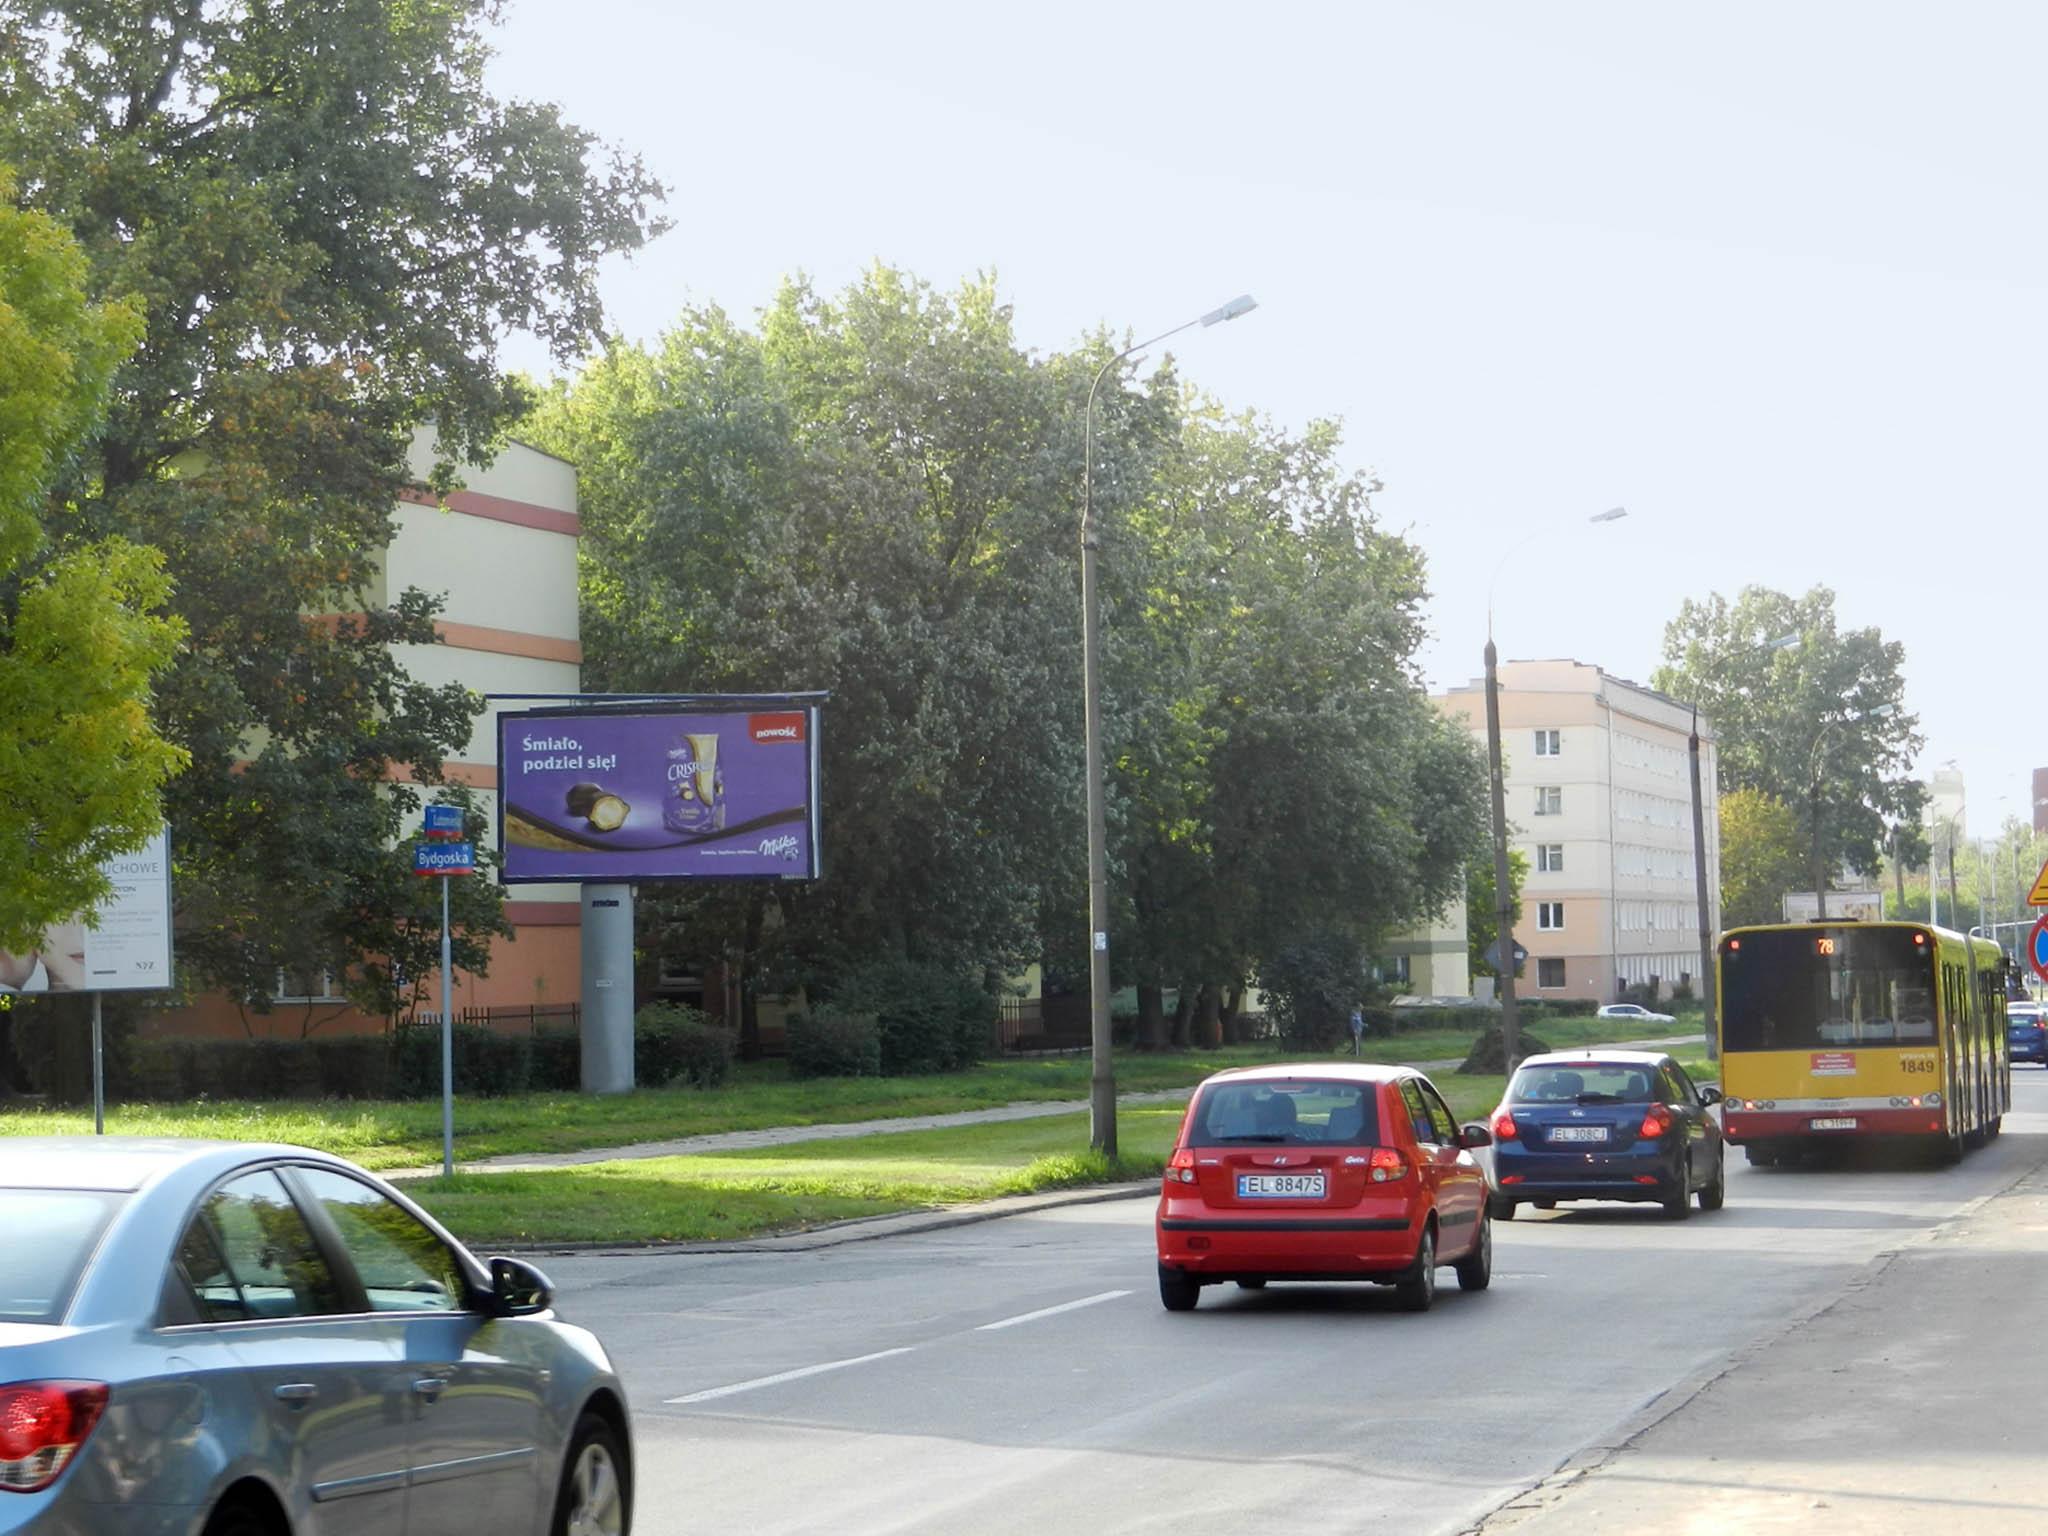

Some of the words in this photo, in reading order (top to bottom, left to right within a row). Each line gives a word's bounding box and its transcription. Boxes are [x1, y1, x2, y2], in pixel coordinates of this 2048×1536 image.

[756, 727, 797, 738] nowość
[522, 733, 583, 752] Śmiało,
[523, 755, 583, 774] podziel
[587, 754, 616, 772] się!
[760, 835, 799, 855] Milka
[418, 851, 469, 868] Bydgoska
[102, 862, 159, 875] UCHOWE
[1818, 938, 1834, 955] 78
[1899, 1060, 1935, 1073] 1849
[1555, 1129, 1568, 1140] EL
[1249, 1177, 1269, 1192] EL
